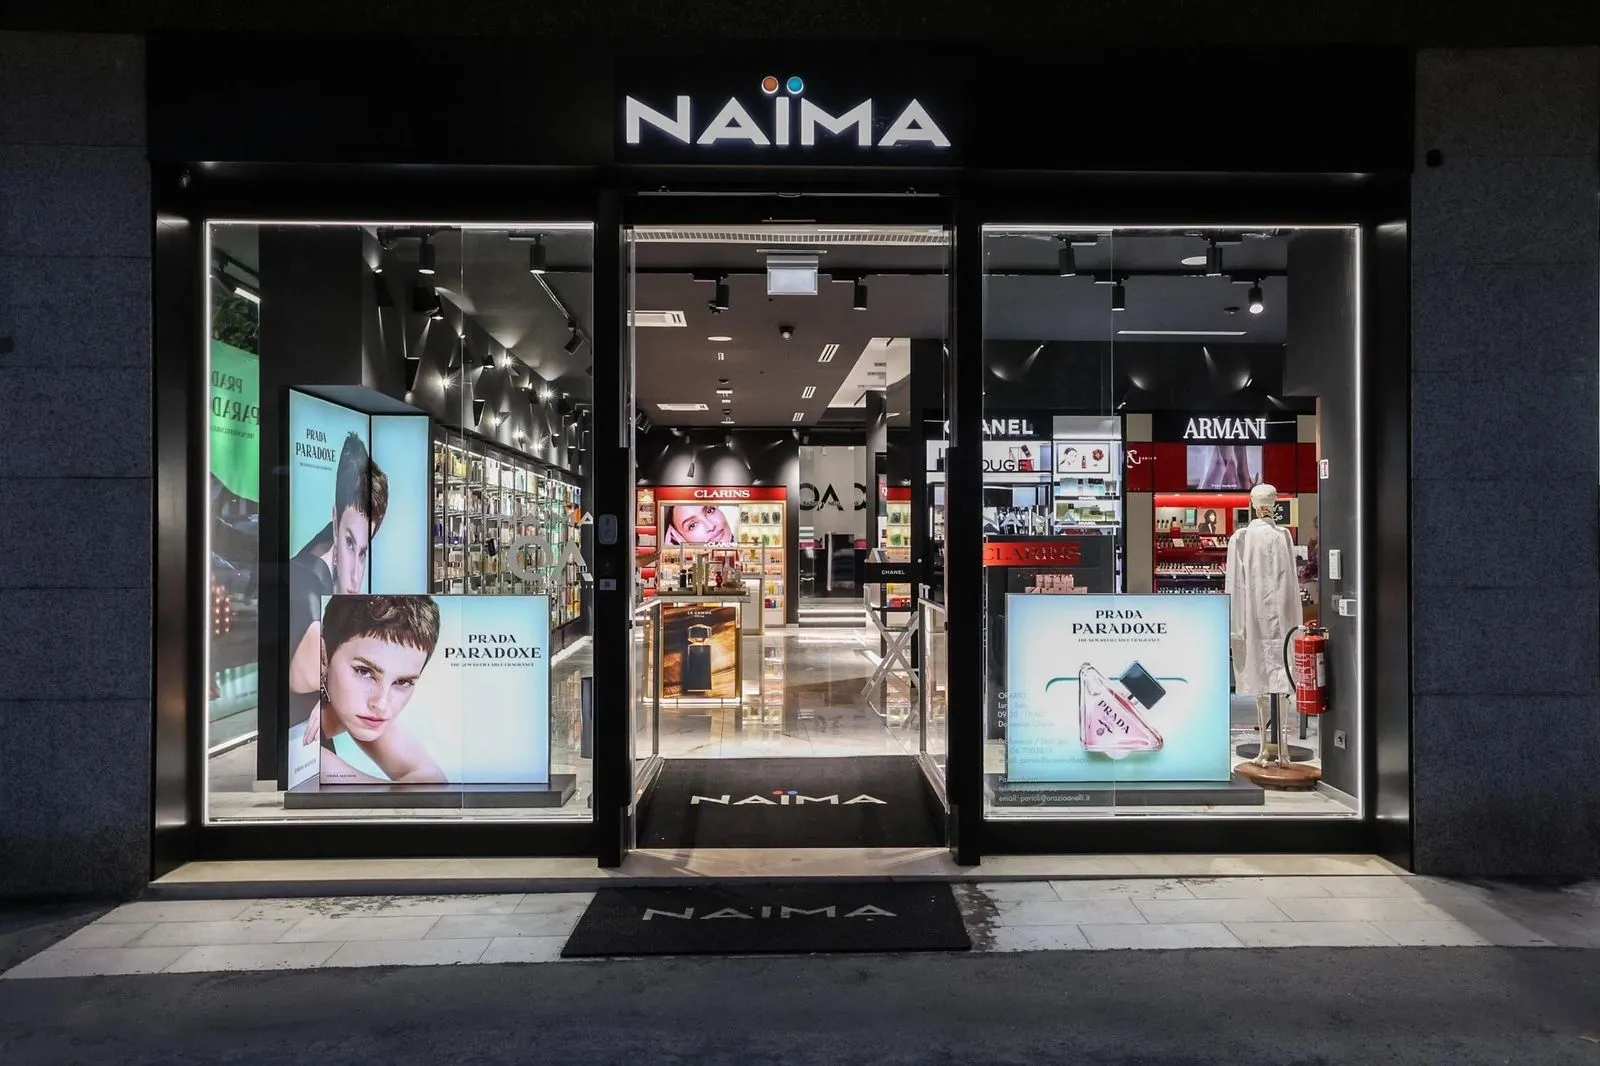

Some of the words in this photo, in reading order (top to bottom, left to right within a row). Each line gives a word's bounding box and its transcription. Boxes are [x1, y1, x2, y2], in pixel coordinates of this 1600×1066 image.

[1183, 417, 1266, 439] ARMANI
[306, 428, 327, 443] PRADA
[295, 441, 336, 463] PARADOXE
[694, 489, 751, 498] CLARINS
[1096, 609, 1143, 619] PRADA
[1072, 623, 1167, 634] PARADOXE
[468, 634, 517, 643] PRADA
[445, 647, 541, 658] PARADOXE
[1097, 700, 1129, 734] PRADA
